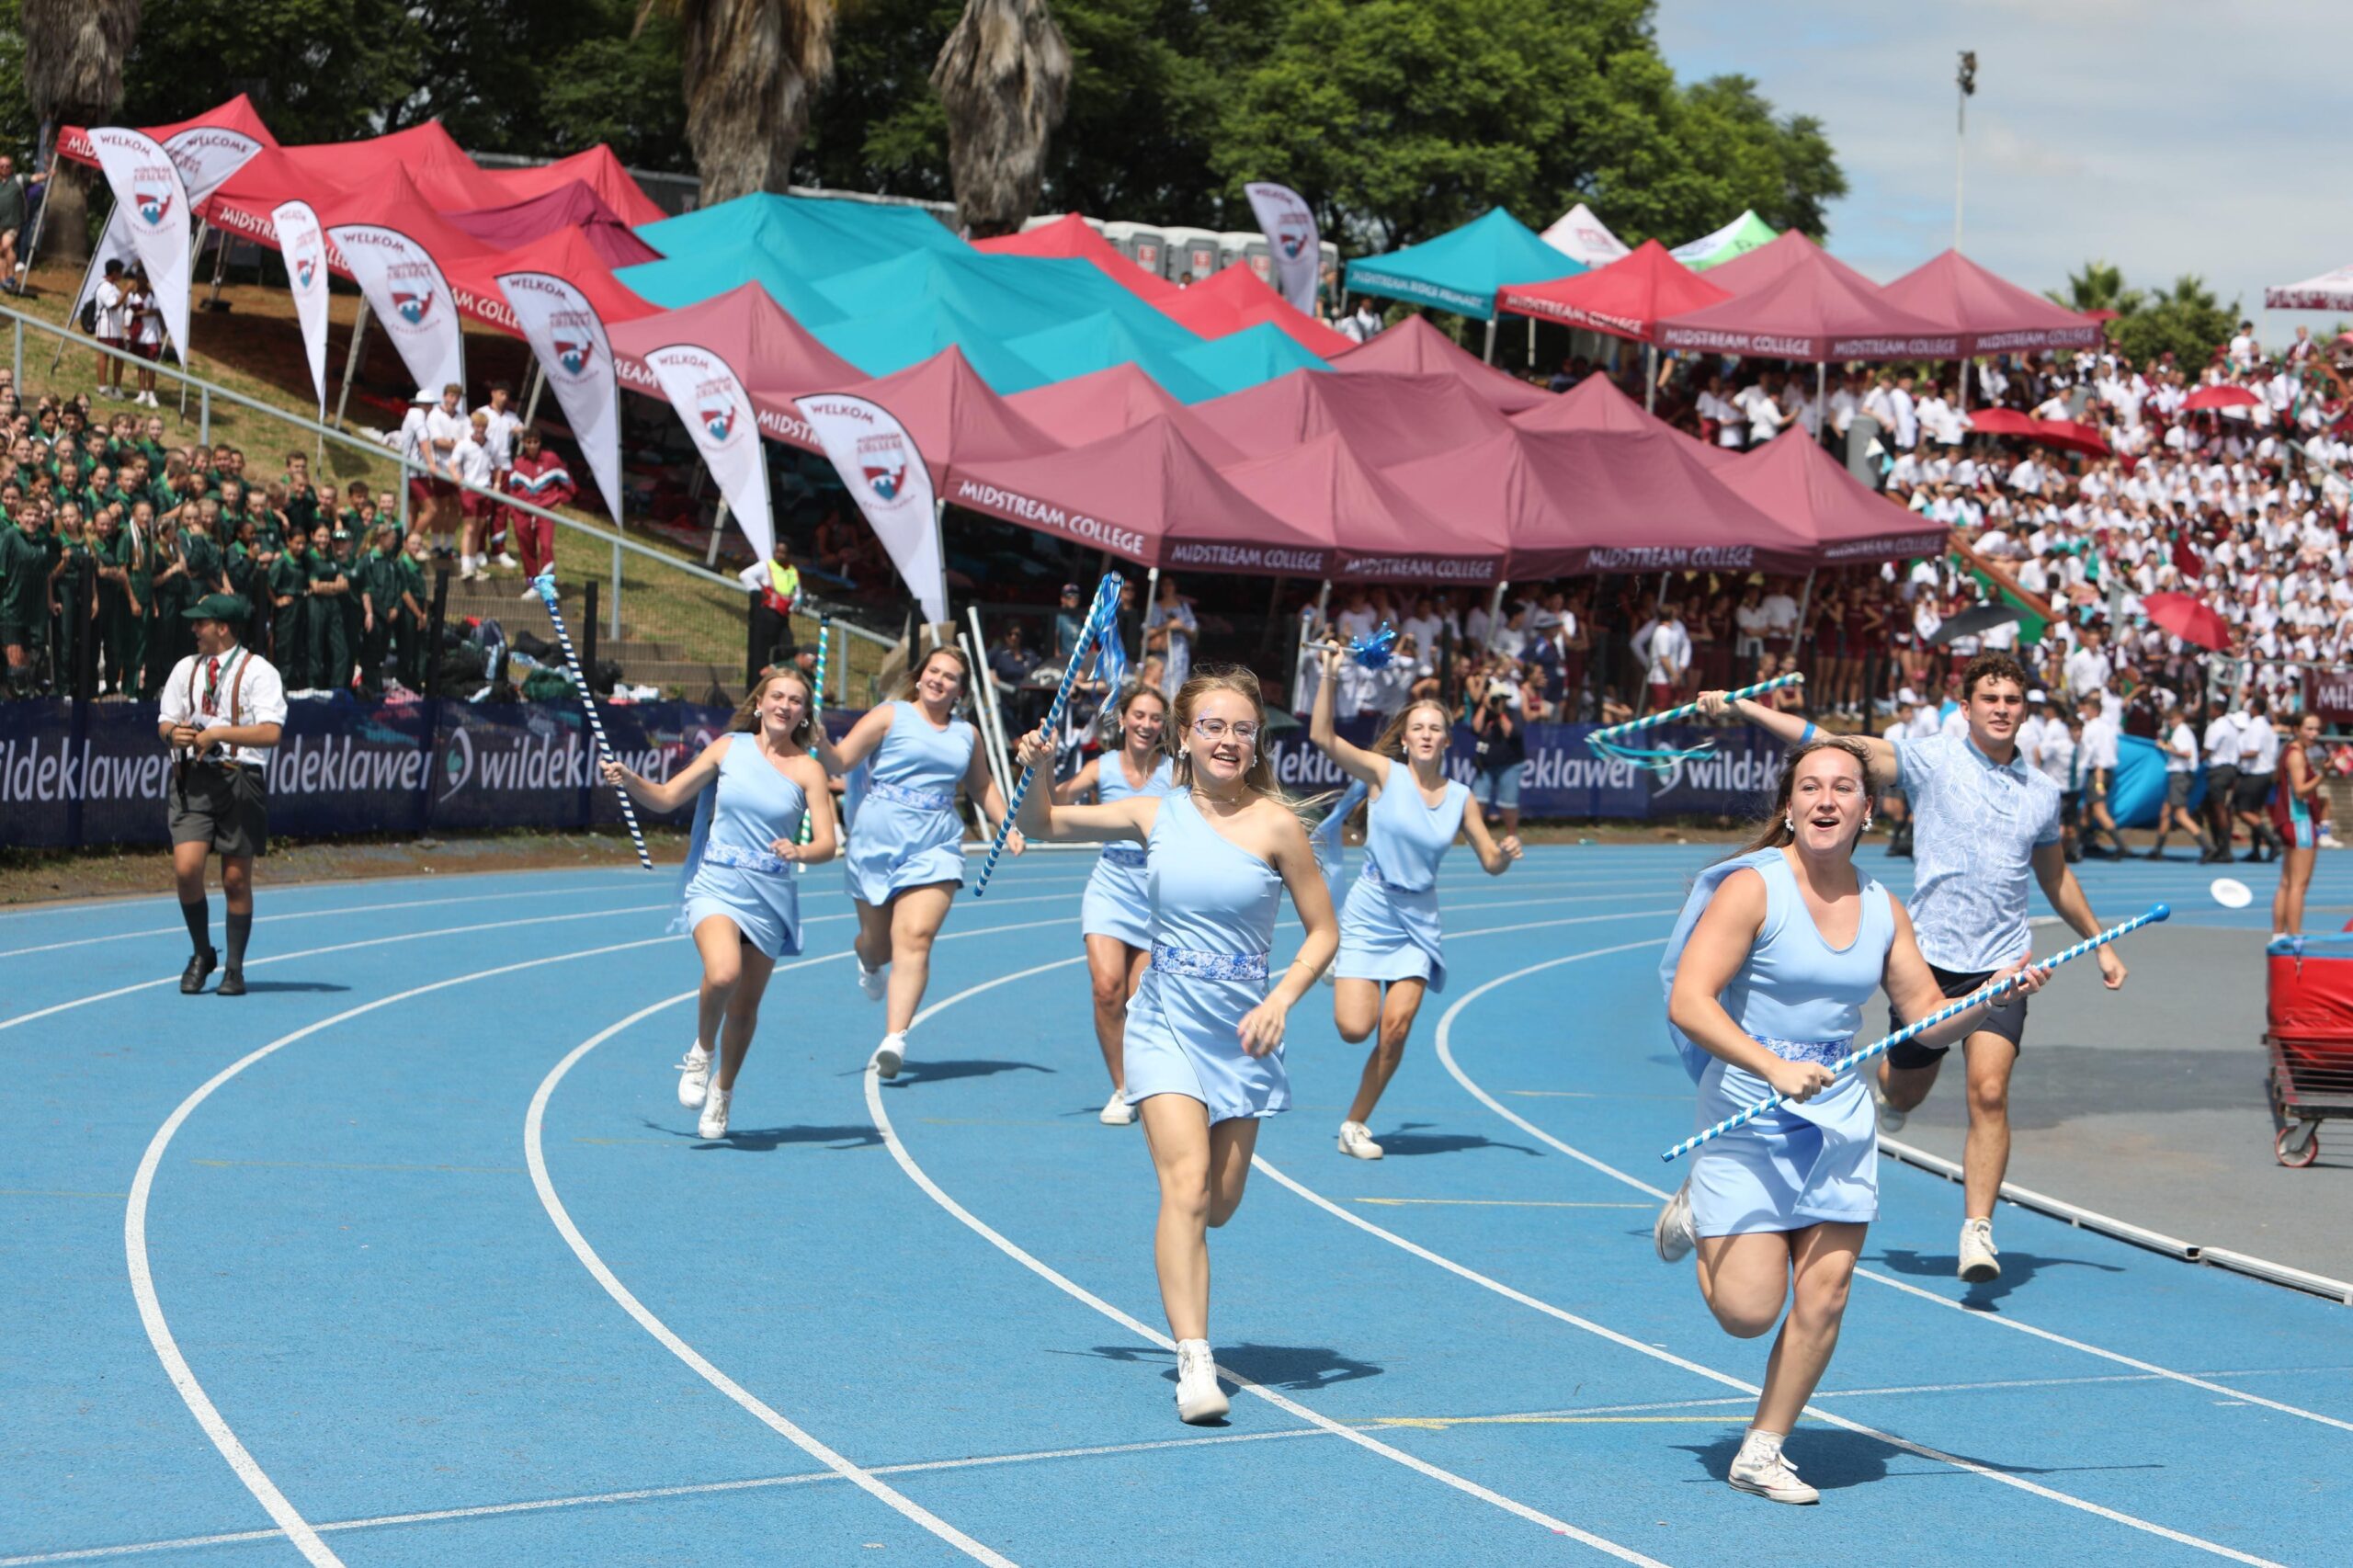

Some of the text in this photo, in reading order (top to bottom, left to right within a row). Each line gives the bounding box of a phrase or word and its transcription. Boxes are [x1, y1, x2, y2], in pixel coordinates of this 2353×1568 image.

[100, 133, 152, 157] WELKOM
[219, 206, 279, 242] MIDSTRE
[343, 233, 404, 253] WELKOM
[509, 277, 566, 301] WELKOM
[476, 298, 521, 329] COLLE
[1665, 328, 1812, 356] MIDSTREAM COLLEGE
[1833, 337, 1958, 357] MIDSTREAM COLLEGE
[1976, 329, 2046, 350] MIDSTREAM
[658, 353, 710, 371] WELKOM
[811, 403, 874, 425] WELKOM
[757, 409, 821, 447] MIDST
[958, 479, 1145, 556] MIDSTREAM COLLEGE
[1170, 544, 1324, 572] MIDSTREAM COLLEGE
[1435, 559, 1495, 579] COLLEGE
[1585, 545, 1754, 569] MIDSTREAM COLLEGE
[0, 737, 172, 801] ldeklawer
[267, 733, 434, 795] ldeklawer
[1687, 748, 1789, 790] wildek
